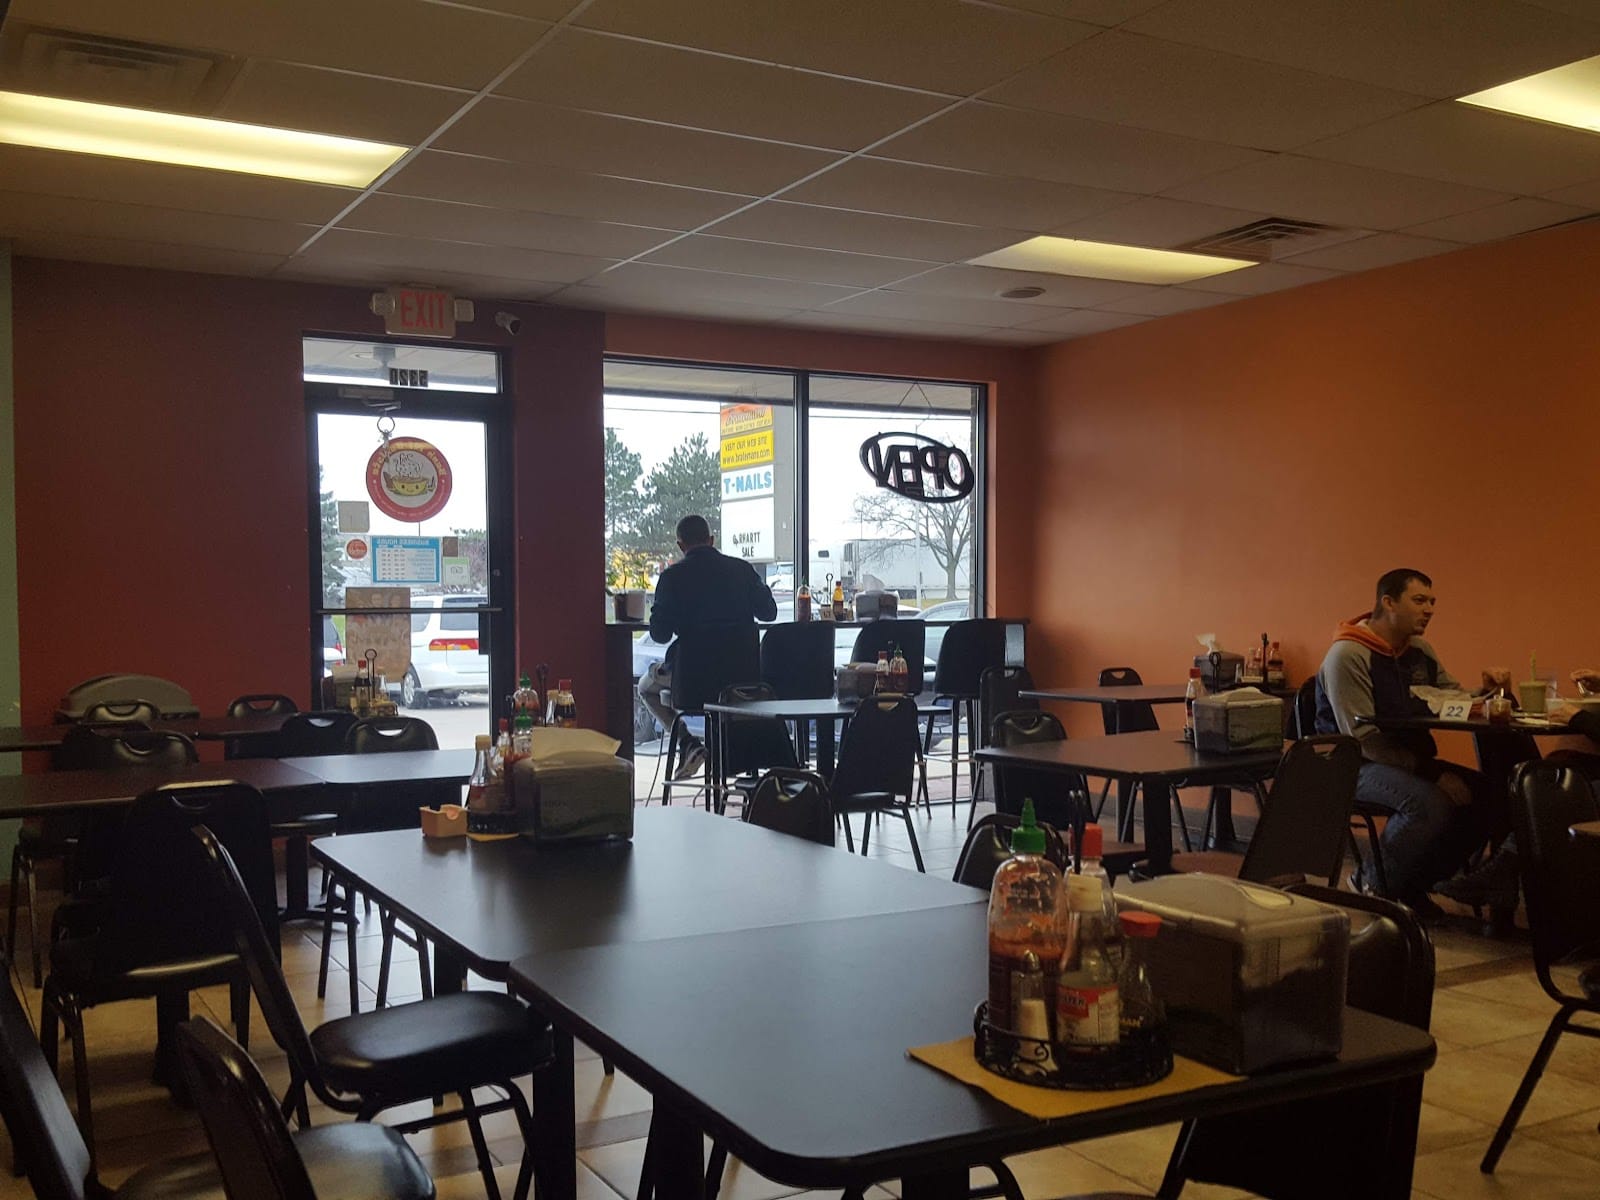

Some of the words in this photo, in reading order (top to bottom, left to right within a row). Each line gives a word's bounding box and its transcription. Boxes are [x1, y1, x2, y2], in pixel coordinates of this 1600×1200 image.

[401, 290, 448, 329] EXIT
[736, 440, 746, 450] OUR
[746, 438, 757, 448] WEB
[757, 435, 768, 446] SITE
[724, 471, 772, 495] T-NAILS
[741, 545, 755, 558] SALE
[1446, 705, 1464, 718] 22
